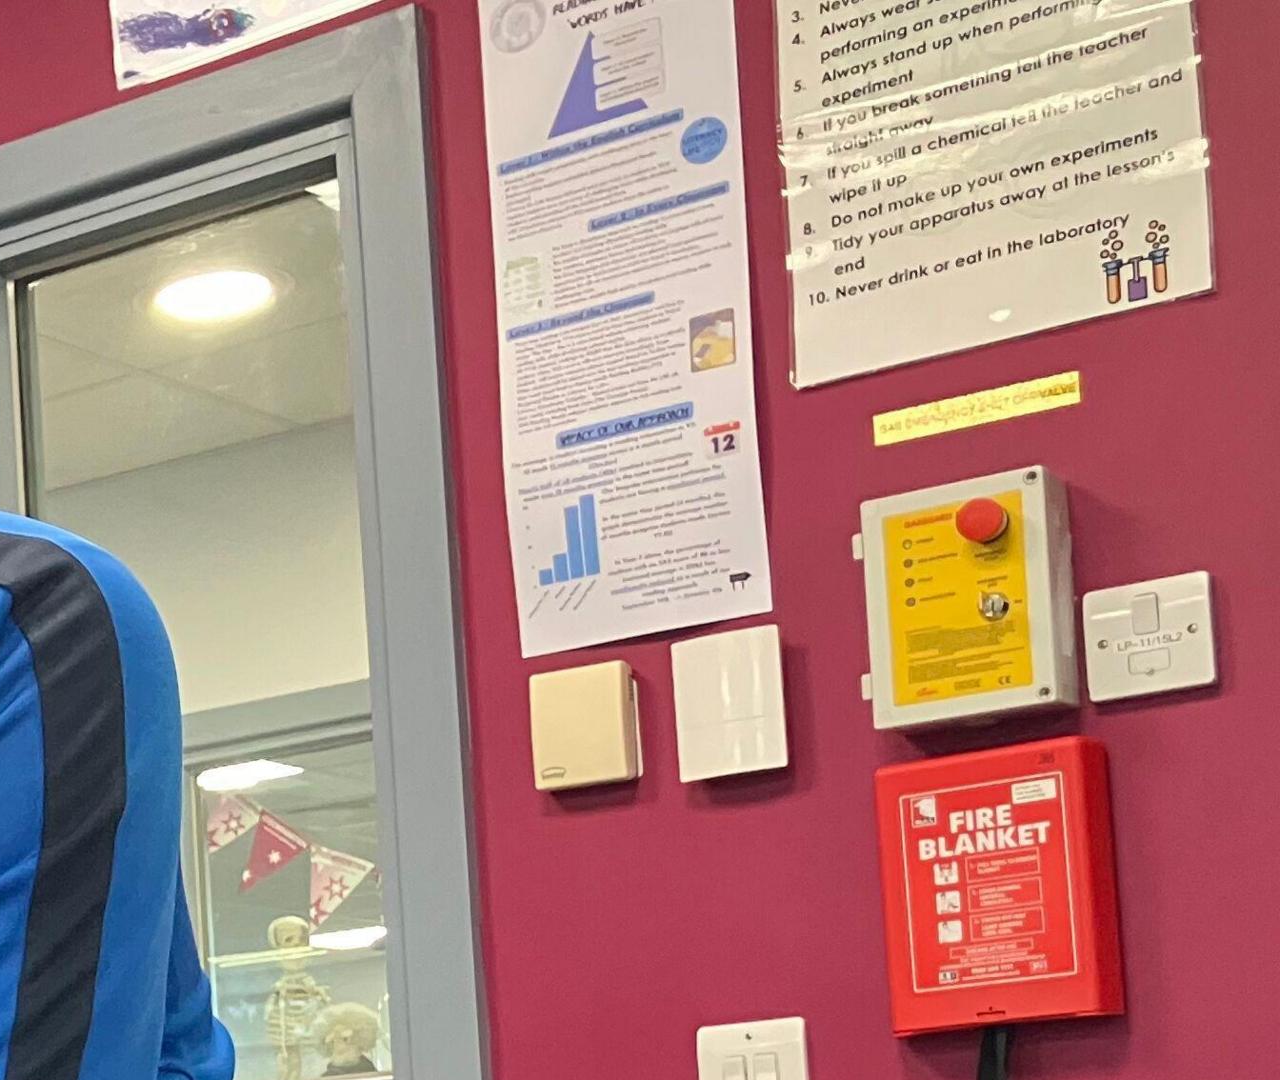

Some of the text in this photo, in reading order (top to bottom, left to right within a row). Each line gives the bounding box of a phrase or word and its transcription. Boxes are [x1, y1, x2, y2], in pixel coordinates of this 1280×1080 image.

[820, 12, 876, 38] Always
[820, 26, 908, 64] performing
[912, 18, 934, 32] an
[822, 59, 878, 84] Always
[882, 43, 927, 65] stand
[932, 34, 953, 50] up
[958, 20, 1004, 42] when
[822, 69, 914, 109] experiment
[837, 110, 867, 134] you
[872, 94, 921, 117] break
[924, 67, 1012, 102] something
[1017, 57, 1042, 75] tell
[1047, 49, 1074, 66] the
[1079, 27, 1148, 57] teacher
[826, 166, 837, 180] If
[840, 160, 872, 178] you
[876, 146, 906, 168] spill
[911, 142, 922, 156] a
[927, 116, 1006, 151] chemical
[1011, 110, 1037, 128] tell
[1042, 101, 1069, 121] the
[1074, 83, 1142, 111] teacher
[1148, 68, 1183, 90] and
[828, 174, 908, 205] wipe it up
[831, 214, 853, 228] Do
[858, 203, 884, 221] not
[888, 190, 936, 212] make
[941, 182, 962, 200] up
[967, 172, 1005, 194] your
[1009, 159, 1045, 180] own
[1051, 128, 1158, 168] experiments
[832, 234, 864, 254] Tidy
[868, 223, 904, 246] your
[909, 200, 994, 231] apparatus
[999, 184, 1047, 208] away
[1052, 176, 1068, 192] at
[1074, 169, 1102, 188] the
[1106, 149, 1175, 178] lesson's
[808, 213, 1130, 307] 10. Never drink or eat in the laboratory
[834, 256, 866, 276] end
[711, 434, 736, 454] 12
[918, 820, 1051, 861] BLANKET
[948, 804, 1012, 834] FIRE
